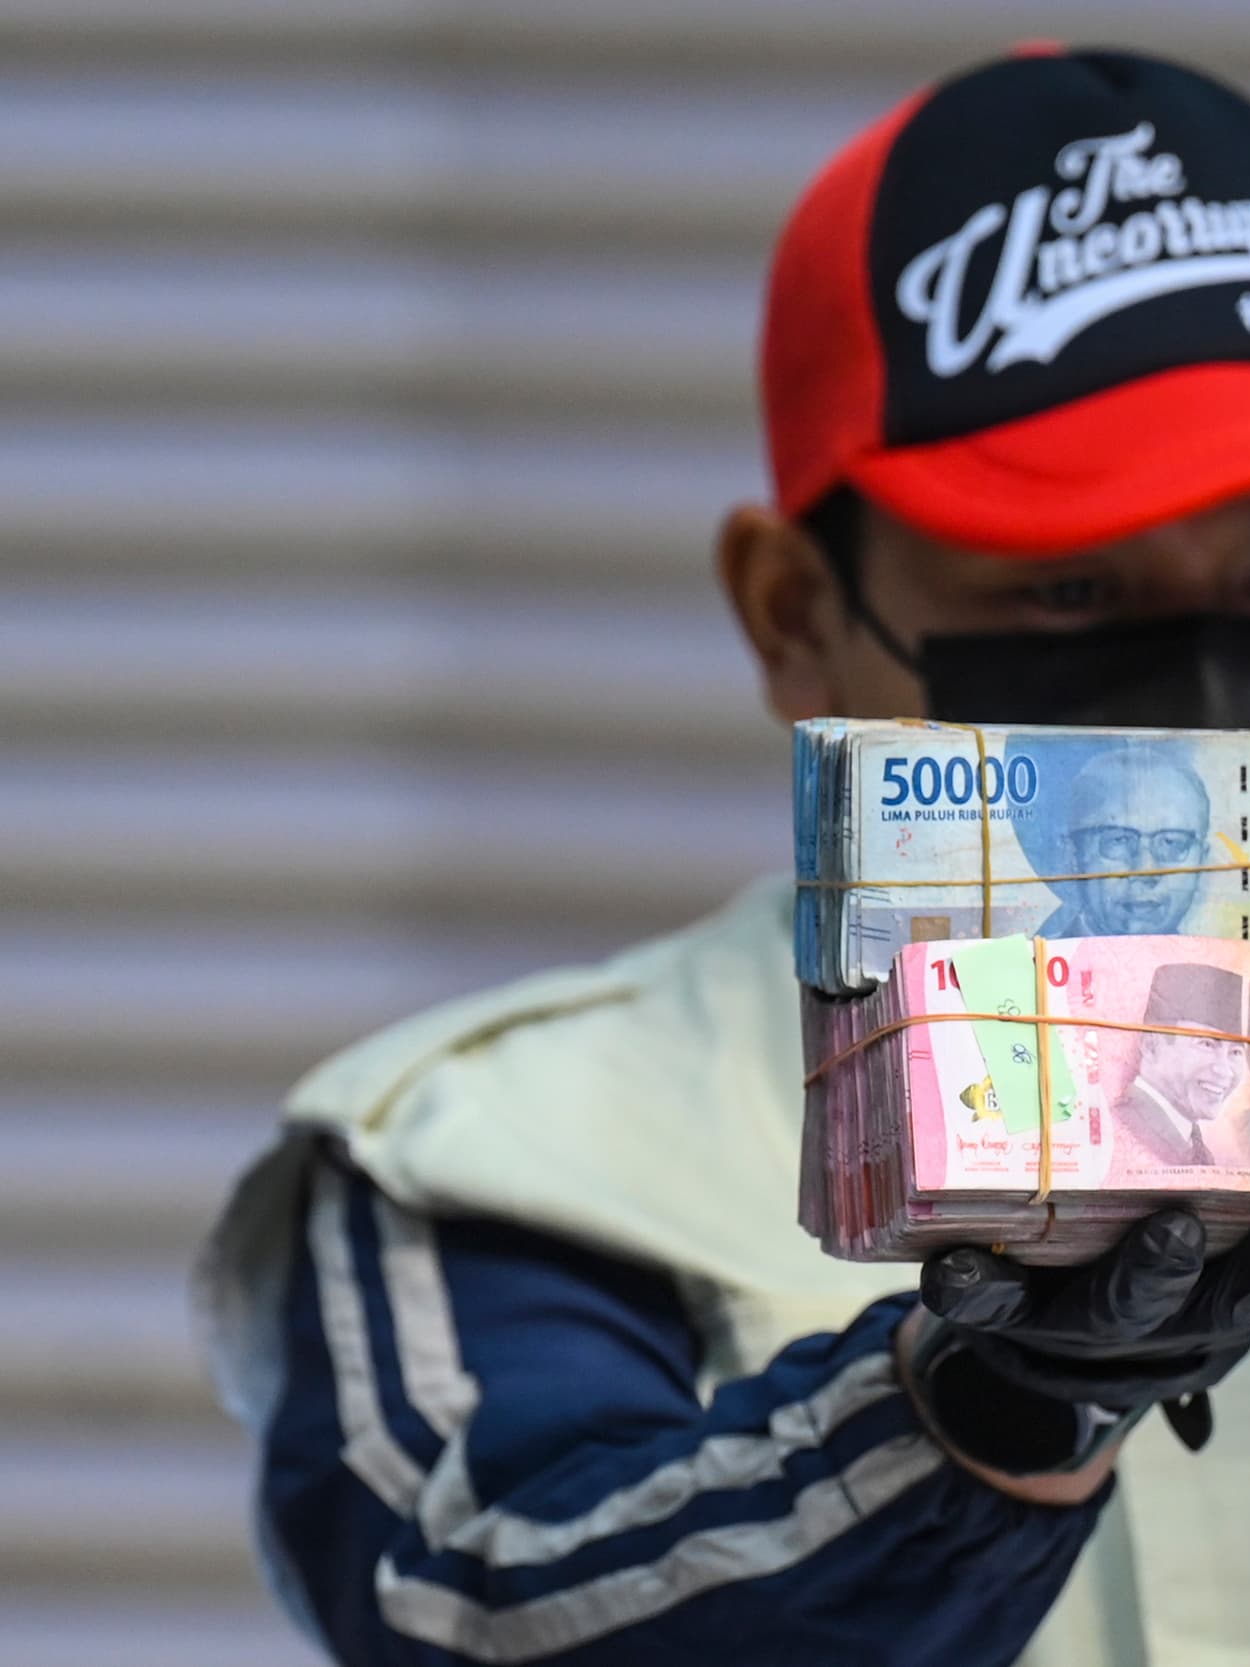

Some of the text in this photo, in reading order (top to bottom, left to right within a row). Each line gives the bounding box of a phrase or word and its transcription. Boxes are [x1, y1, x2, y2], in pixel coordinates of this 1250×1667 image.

[1050, 121, 1187, 234] The
[881, 757, 1036, 806] 50000
[881, 811, 911, 822] LIMA
[915, 810, 955, 821] PULUH
